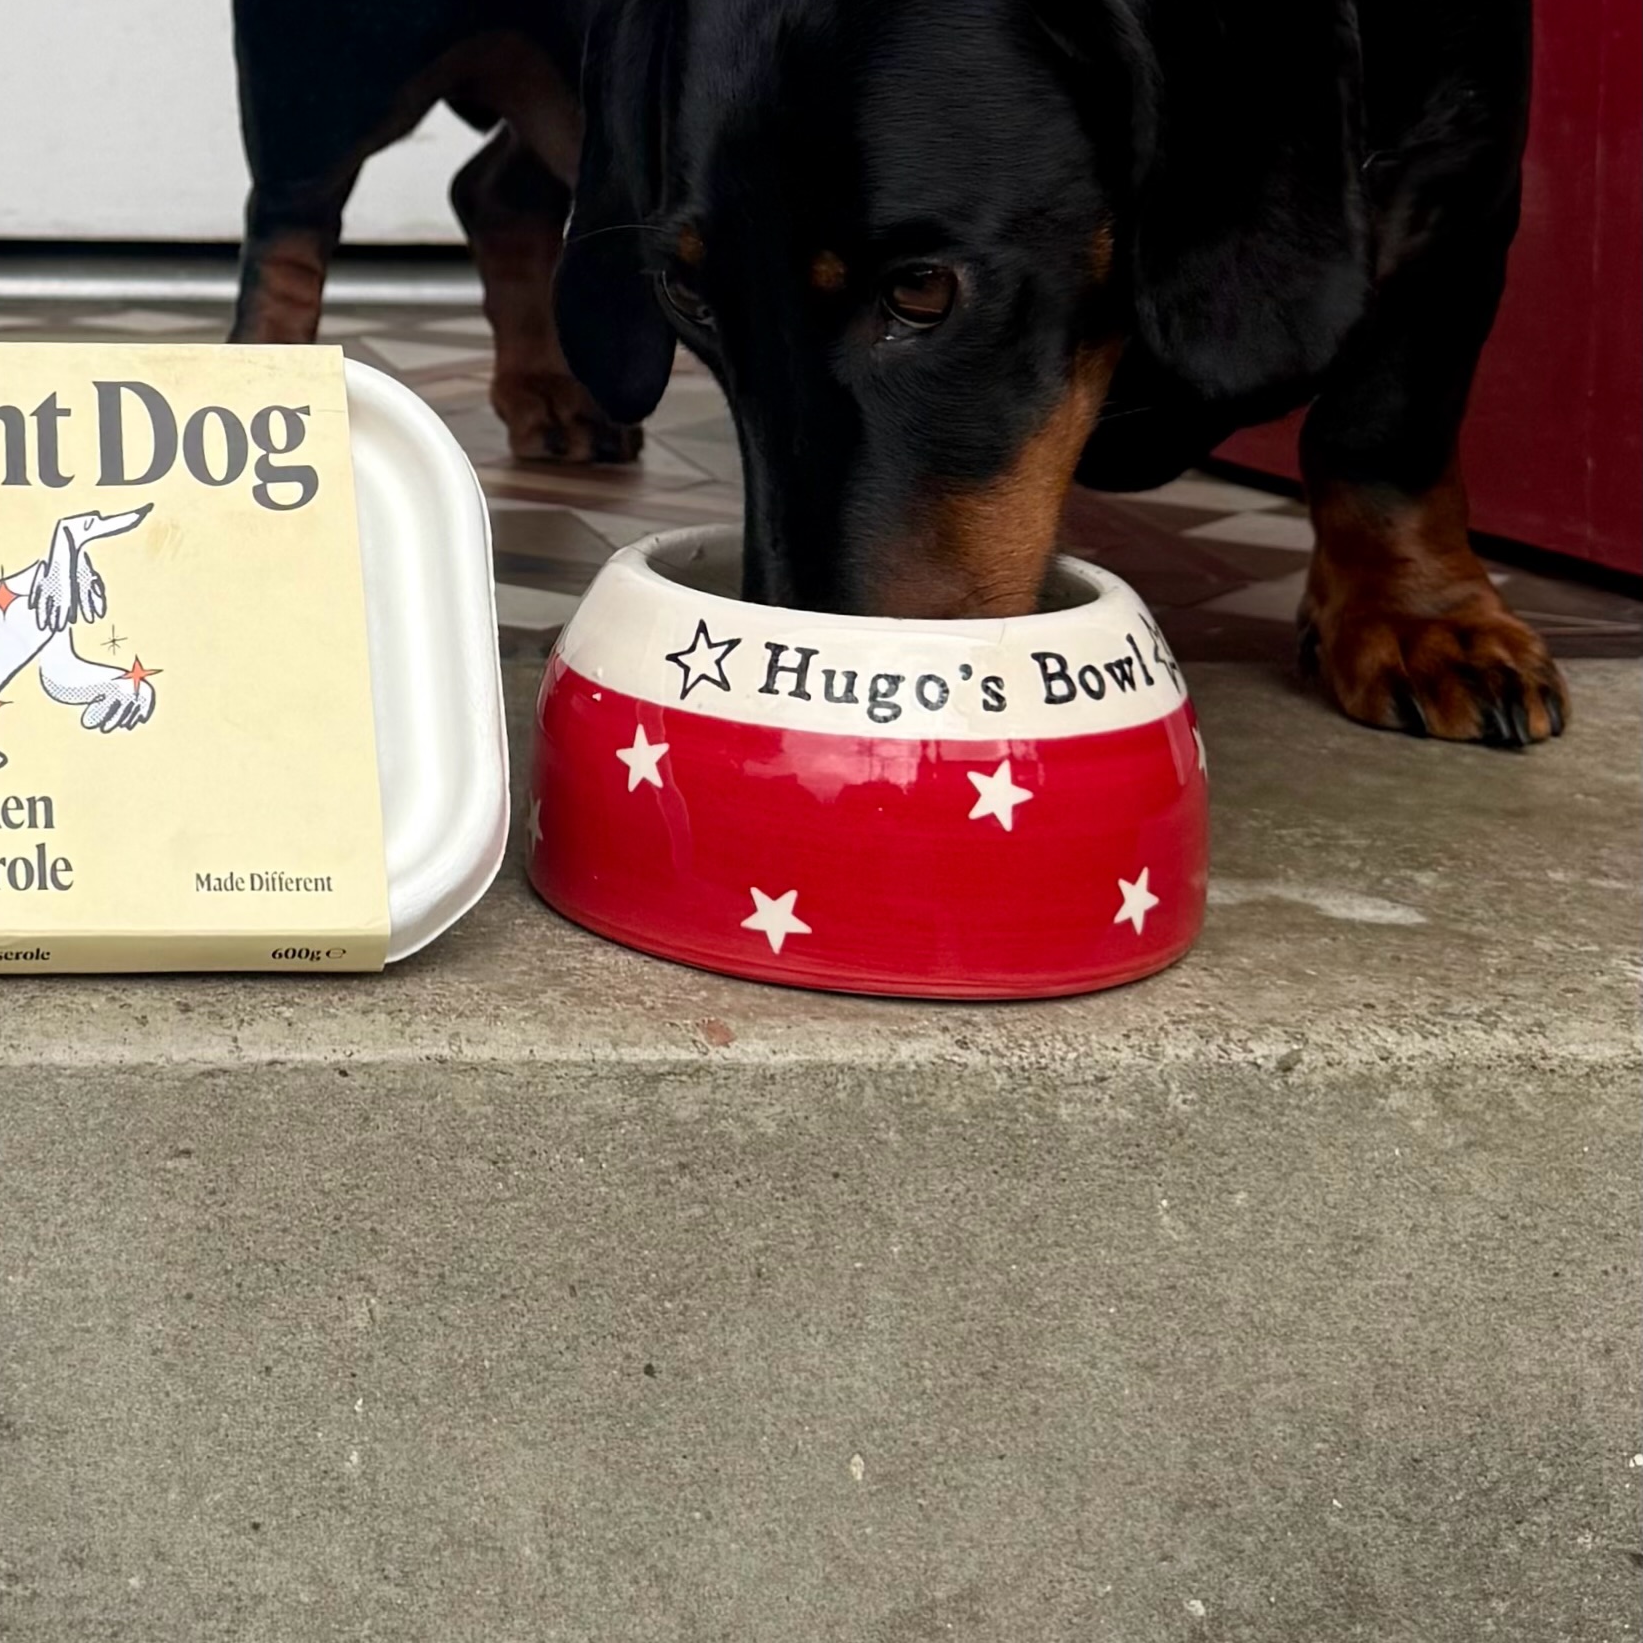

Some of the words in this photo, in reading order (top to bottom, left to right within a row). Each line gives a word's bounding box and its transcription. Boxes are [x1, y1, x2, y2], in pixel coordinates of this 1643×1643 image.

[92, 381, 319, 511] Dog
[758, 642, 1006, 723] Hugo's
[1031, 634, 1156, 706] Bowl
[195, 871, 245, 892] Made
[249, 871, 333, 892] Different
[271, 947, 321, 962] 600g
